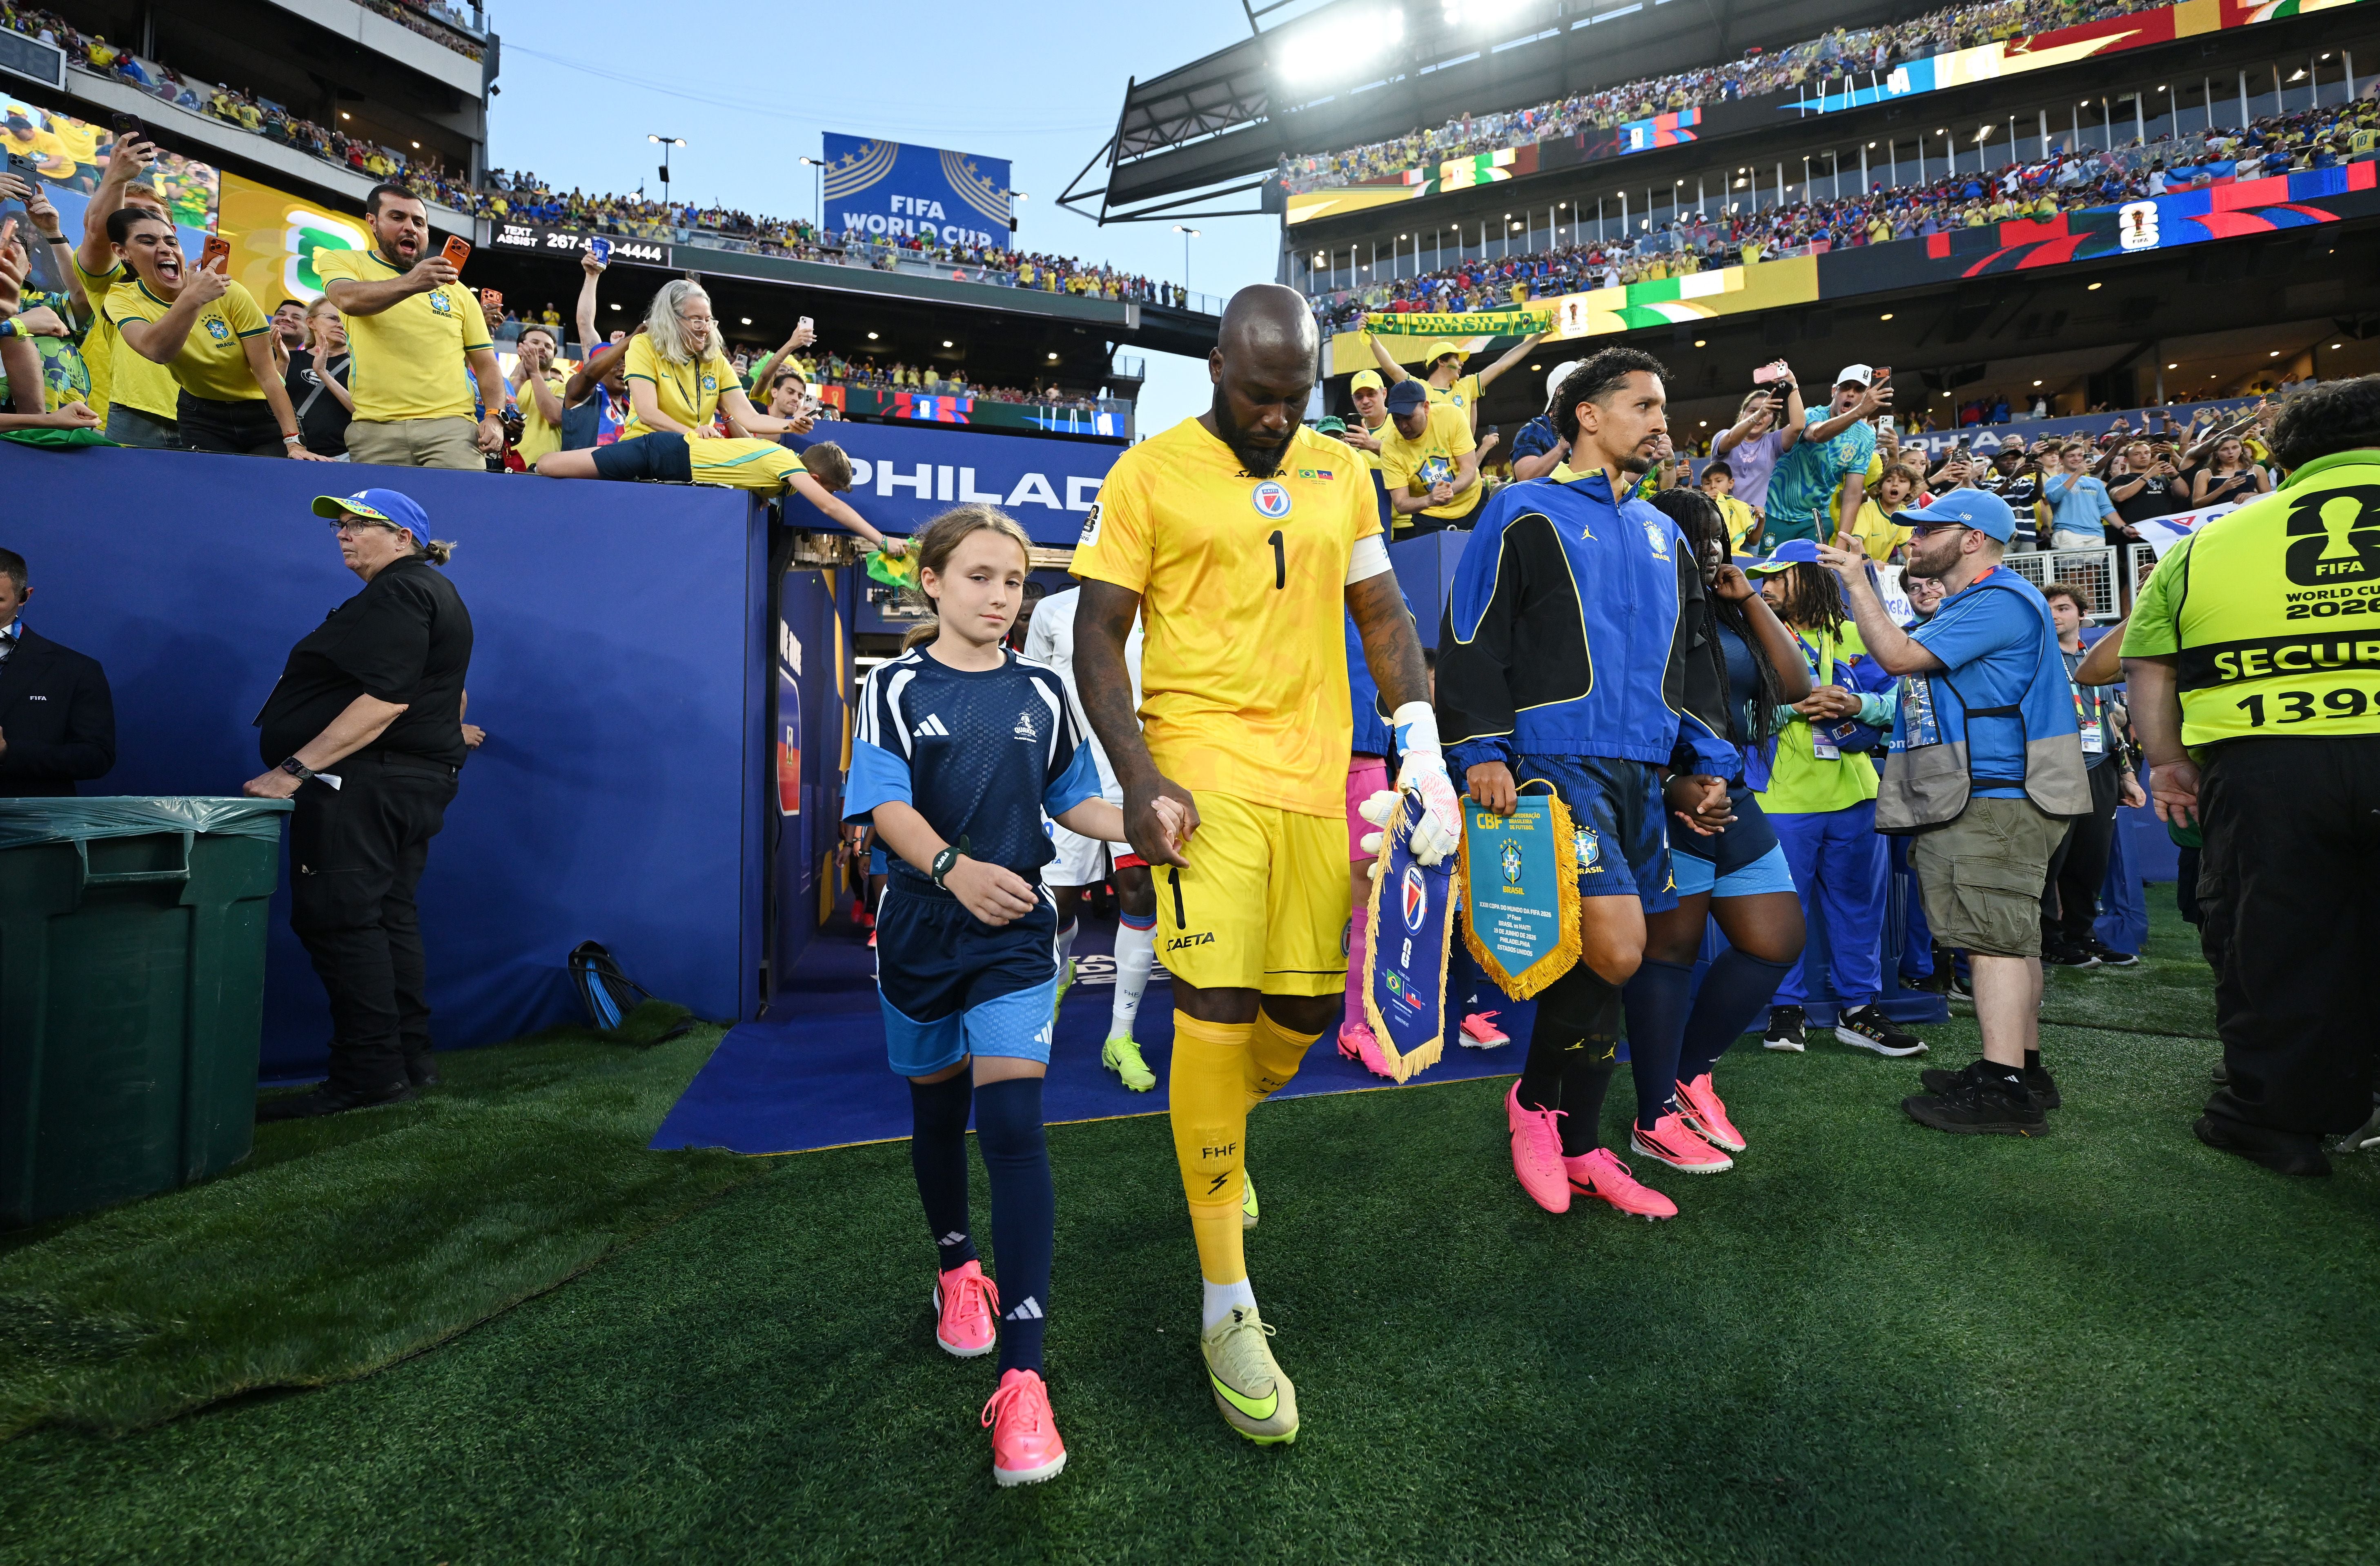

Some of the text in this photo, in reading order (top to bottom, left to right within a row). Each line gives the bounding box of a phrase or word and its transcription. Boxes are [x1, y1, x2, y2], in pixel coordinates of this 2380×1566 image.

[2357, 135, 2367, 147] 10
[891, 195, 946, 220] FIFA
[503, 225, 532, 236] TEXT
[843, 213, 992, 247] WORLD CUP
[496, 234, 538, 247] ASSIST
[547, 233, 662, 261] 267-50-4444
[432, 310, 452, 319] BRASIL
[1415, 316, 1503, 333] BRASIL
[1430, 472, 1443, 482] CBF
[1959, 512, 1972, 521] HB
[1268, 530, 1285, 590] 1
[1652, 552, 1671, 562] BRASIL
[2316, 561, 2365, 576] FIFA
[2286, 588, 2352, 602] WORLD
[2214, 641, 2380, 680] SECUR
[2236, 688, 2380, 727] 139
[1014, 727, 1036, 737] QUAKER
[1476, 813, 1503, 829] CBF
[935, 852, 950, 869] FIFA
[1411, 873, 1421, 887] HAITI
[1503, 885, 1525, 895] BRASIL
[1168, 867, 1186, 930] 1
[1167, 932, 1215, 952] SAETA
[1499, 937, 1530, 948] PHILADELPHIA
[1497, 944, 1533, 957] ESTADOS UNIDOS
[1202, 1142, 1236, 1159] FHF
